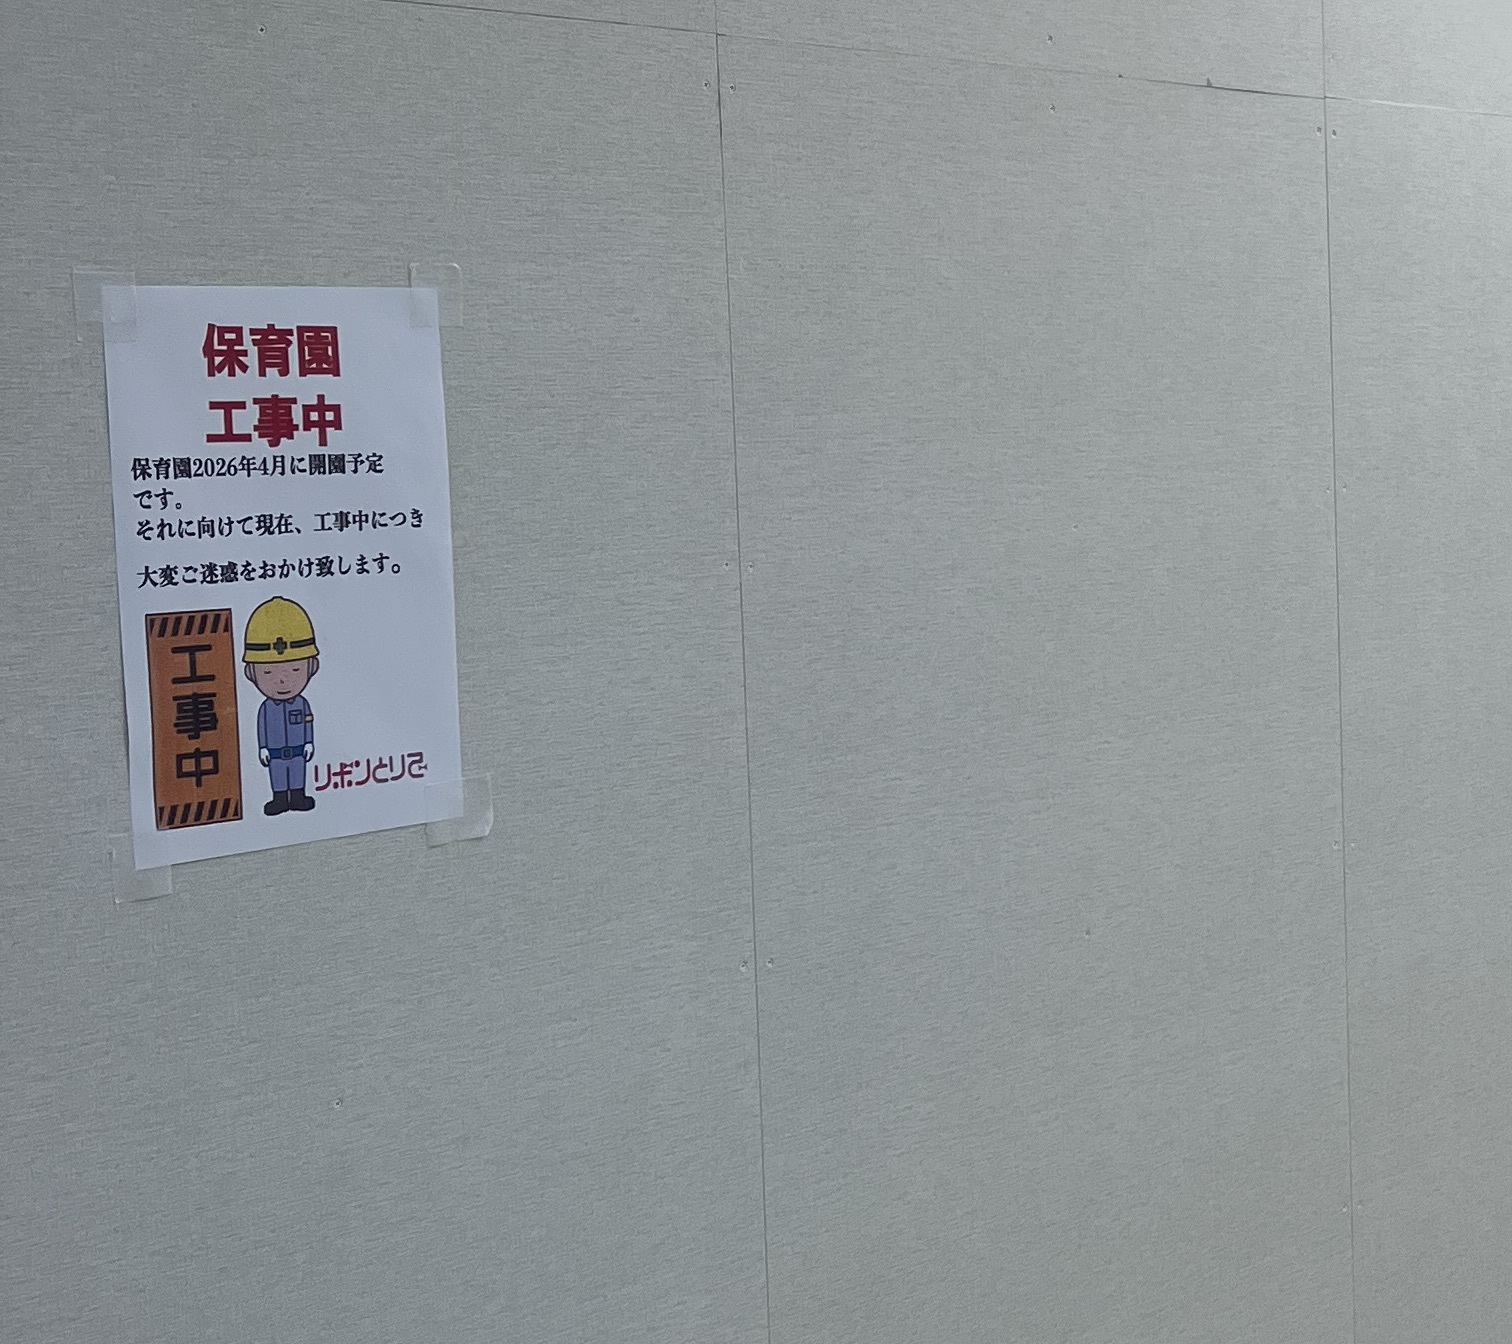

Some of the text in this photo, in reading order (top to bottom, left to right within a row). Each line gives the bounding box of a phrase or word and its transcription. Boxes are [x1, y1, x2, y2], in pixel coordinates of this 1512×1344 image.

[201, 323, 341, 378] 保育園
[205, 394, 344, 447] 工事中
[131, 453, 384, 481] 保育園2026年4月に開園予定
[133, 488, 182, 510] です。
[136, 508, 424, 540] それに向けて現在、工事中につき
[137, 552, 401, 588] 大変ご迷惑をおかけ致します。
[170, 643, 219, 789] 工事中
